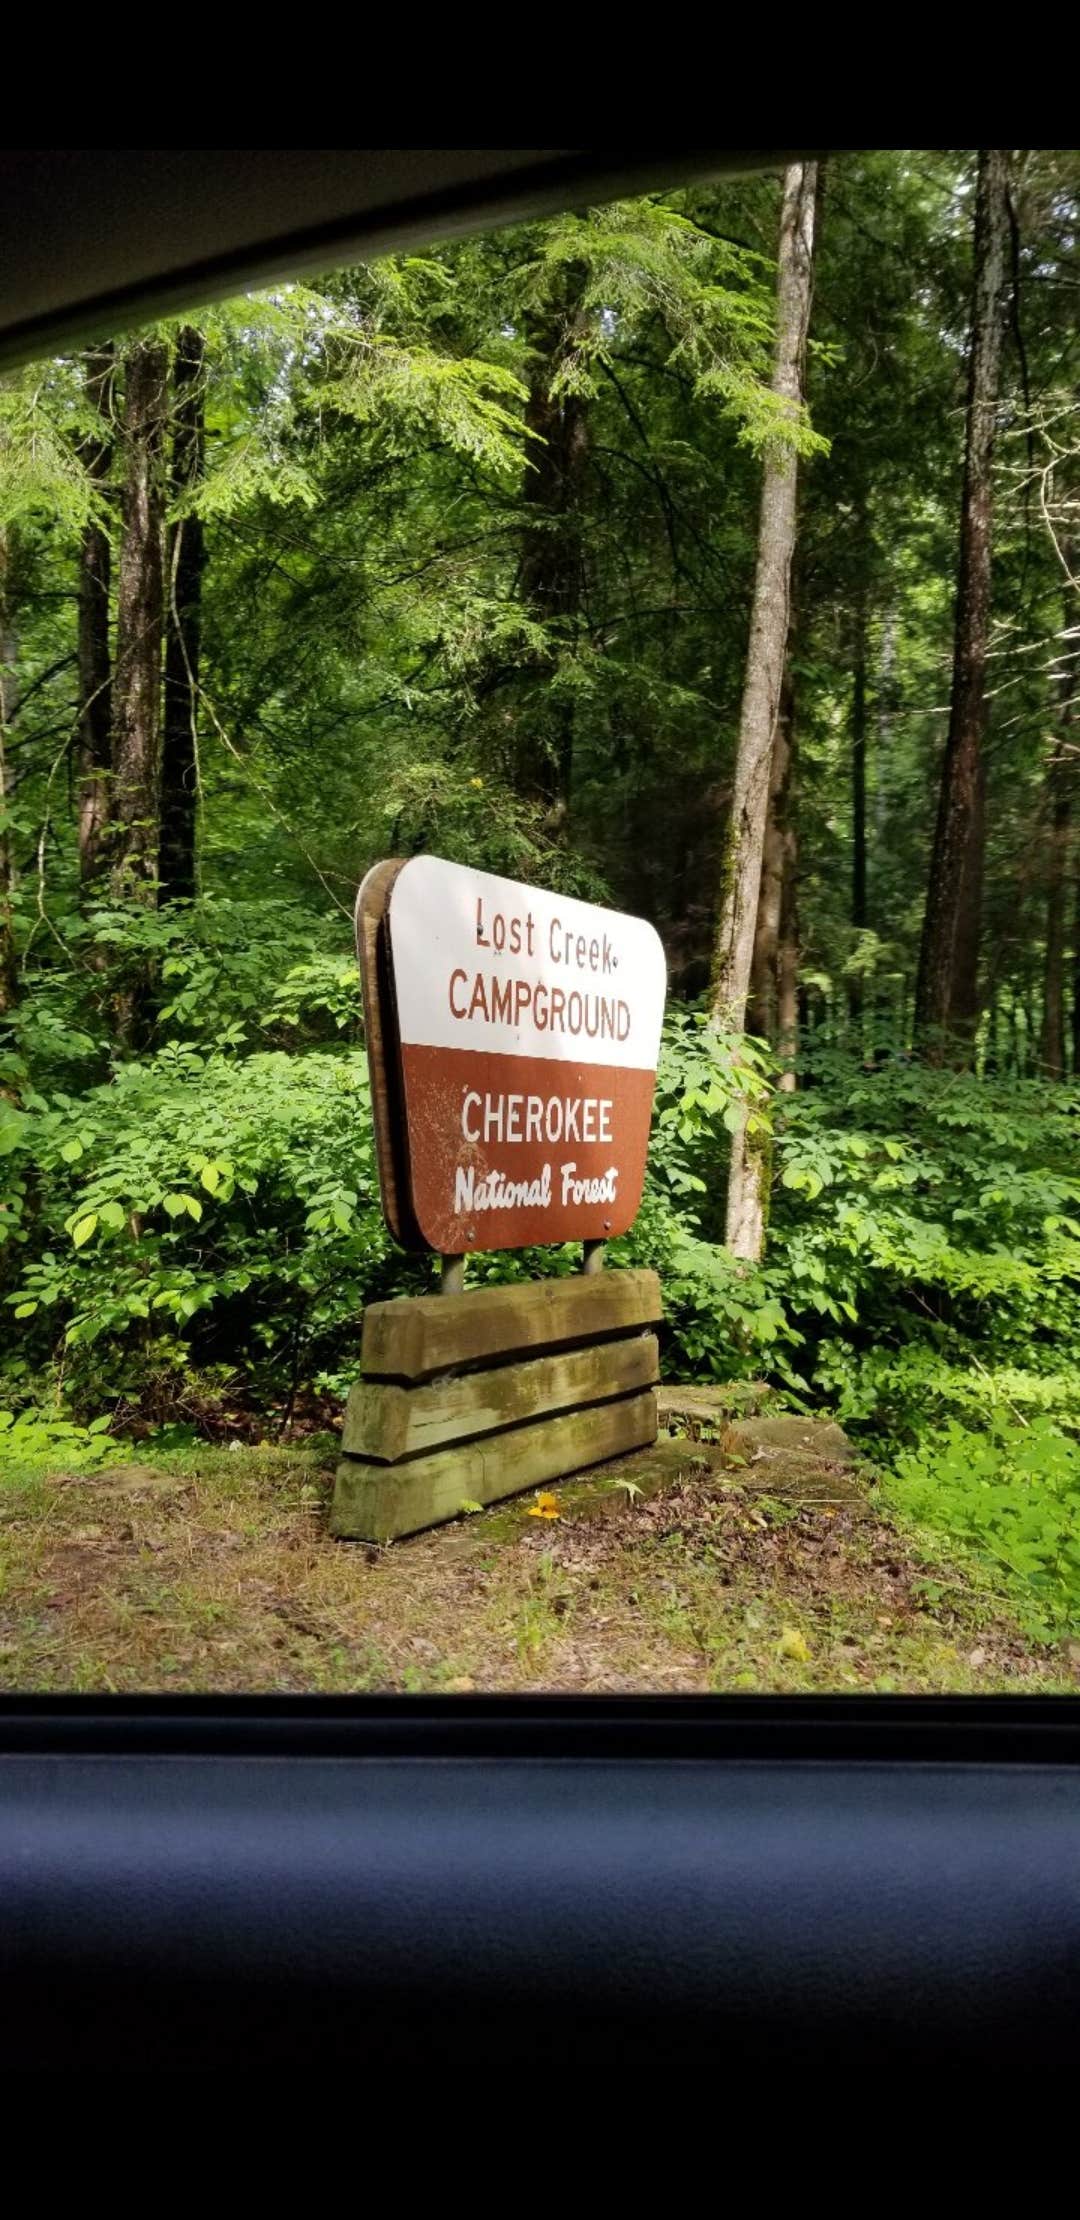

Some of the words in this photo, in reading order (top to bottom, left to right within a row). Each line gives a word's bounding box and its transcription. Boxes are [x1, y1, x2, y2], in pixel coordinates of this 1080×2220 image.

[476, 898, 534, 957] Lost
[549, 918, 613, 975] Creek
[448, 968, 631, 1042] CAMPGROUND
[461, 1091, 613, 1143] CHEROKEE
[454, 1163, 551, 1214] National
[560, 1161, 618, 1206] Forest
